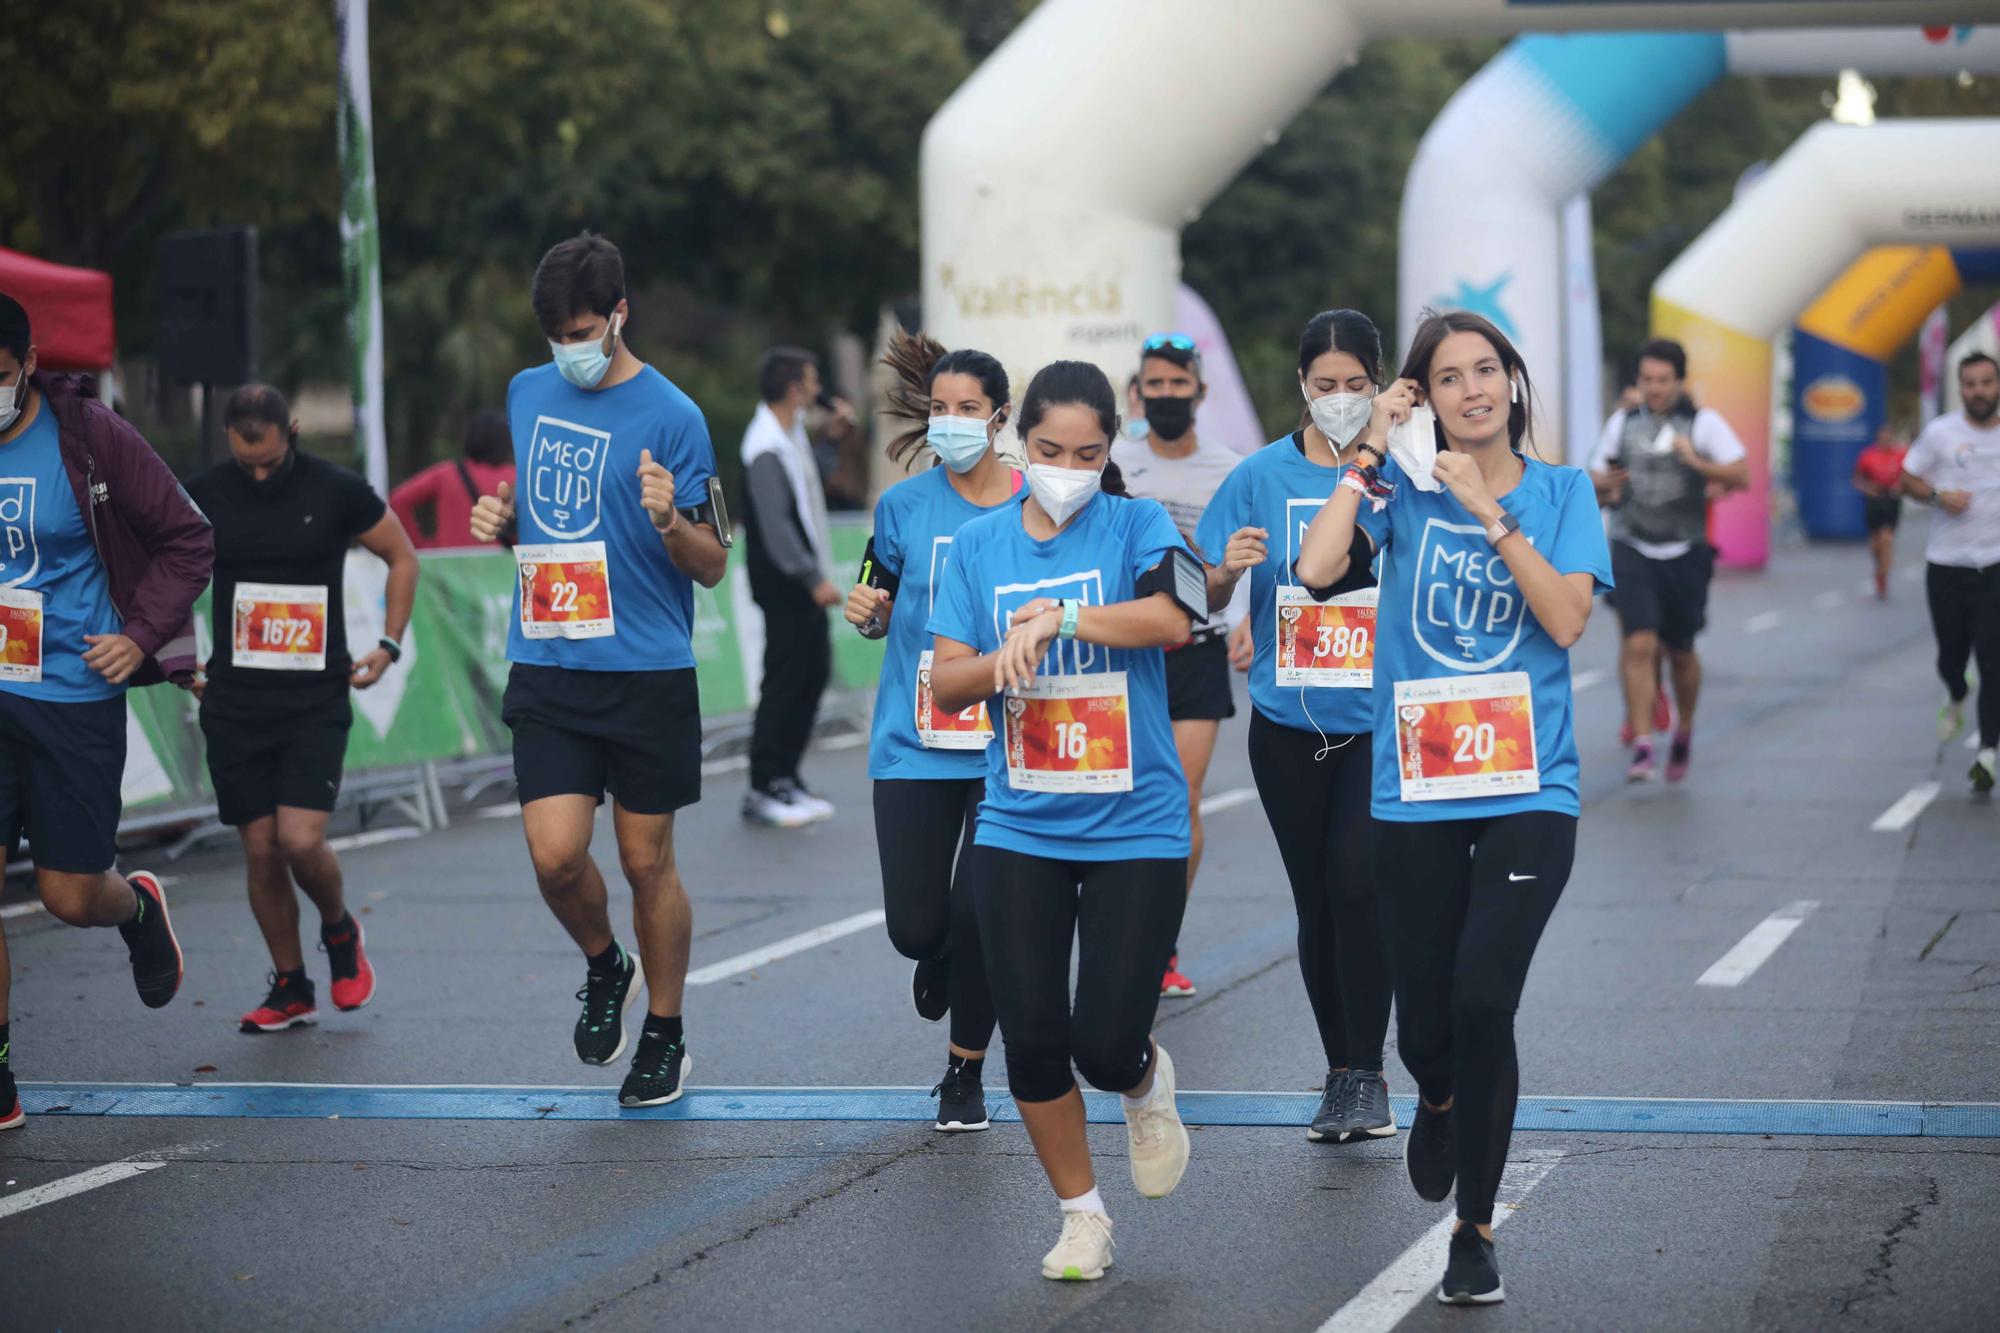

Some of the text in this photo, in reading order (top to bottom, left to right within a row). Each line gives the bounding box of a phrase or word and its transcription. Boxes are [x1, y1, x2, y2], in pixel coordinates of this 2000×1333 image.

[535, 466, 592, 510] CUP
[551, 581, 578, 612] 22
[1427, 582, 1513, 633] CUP
[262, 617, 312, 647] 1672
[1313, 626, 1368, 658] 380
[1055, 721, 1088, 759] 16
[1453, 722, 1496, 763] 20
